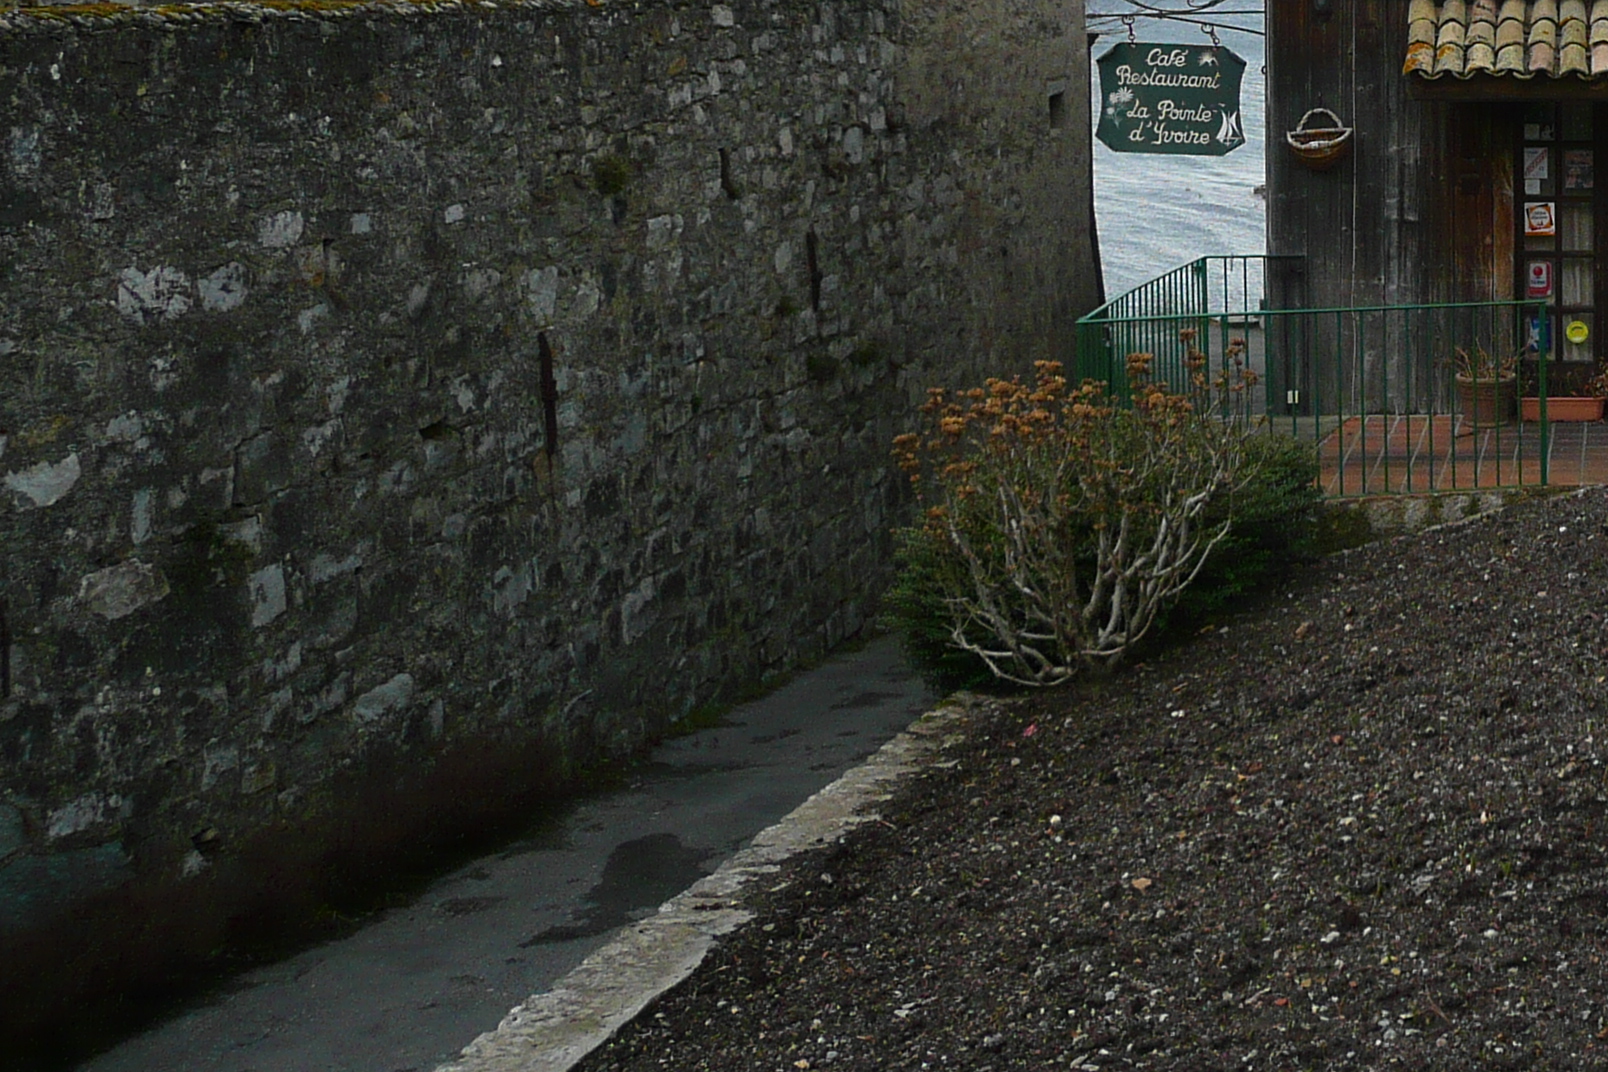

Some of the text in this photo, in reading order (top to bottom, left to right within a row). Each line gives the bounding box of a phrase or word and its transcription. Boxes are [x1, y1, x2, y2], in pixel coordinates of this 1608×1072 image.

[1145, 48, 1190, 67] Café
[1116, 65, 1221, 89] Restaurant
[1126, 99, 1213, 123] La Pointe
[1128, 121, 1210, 145] d'Yvoire
